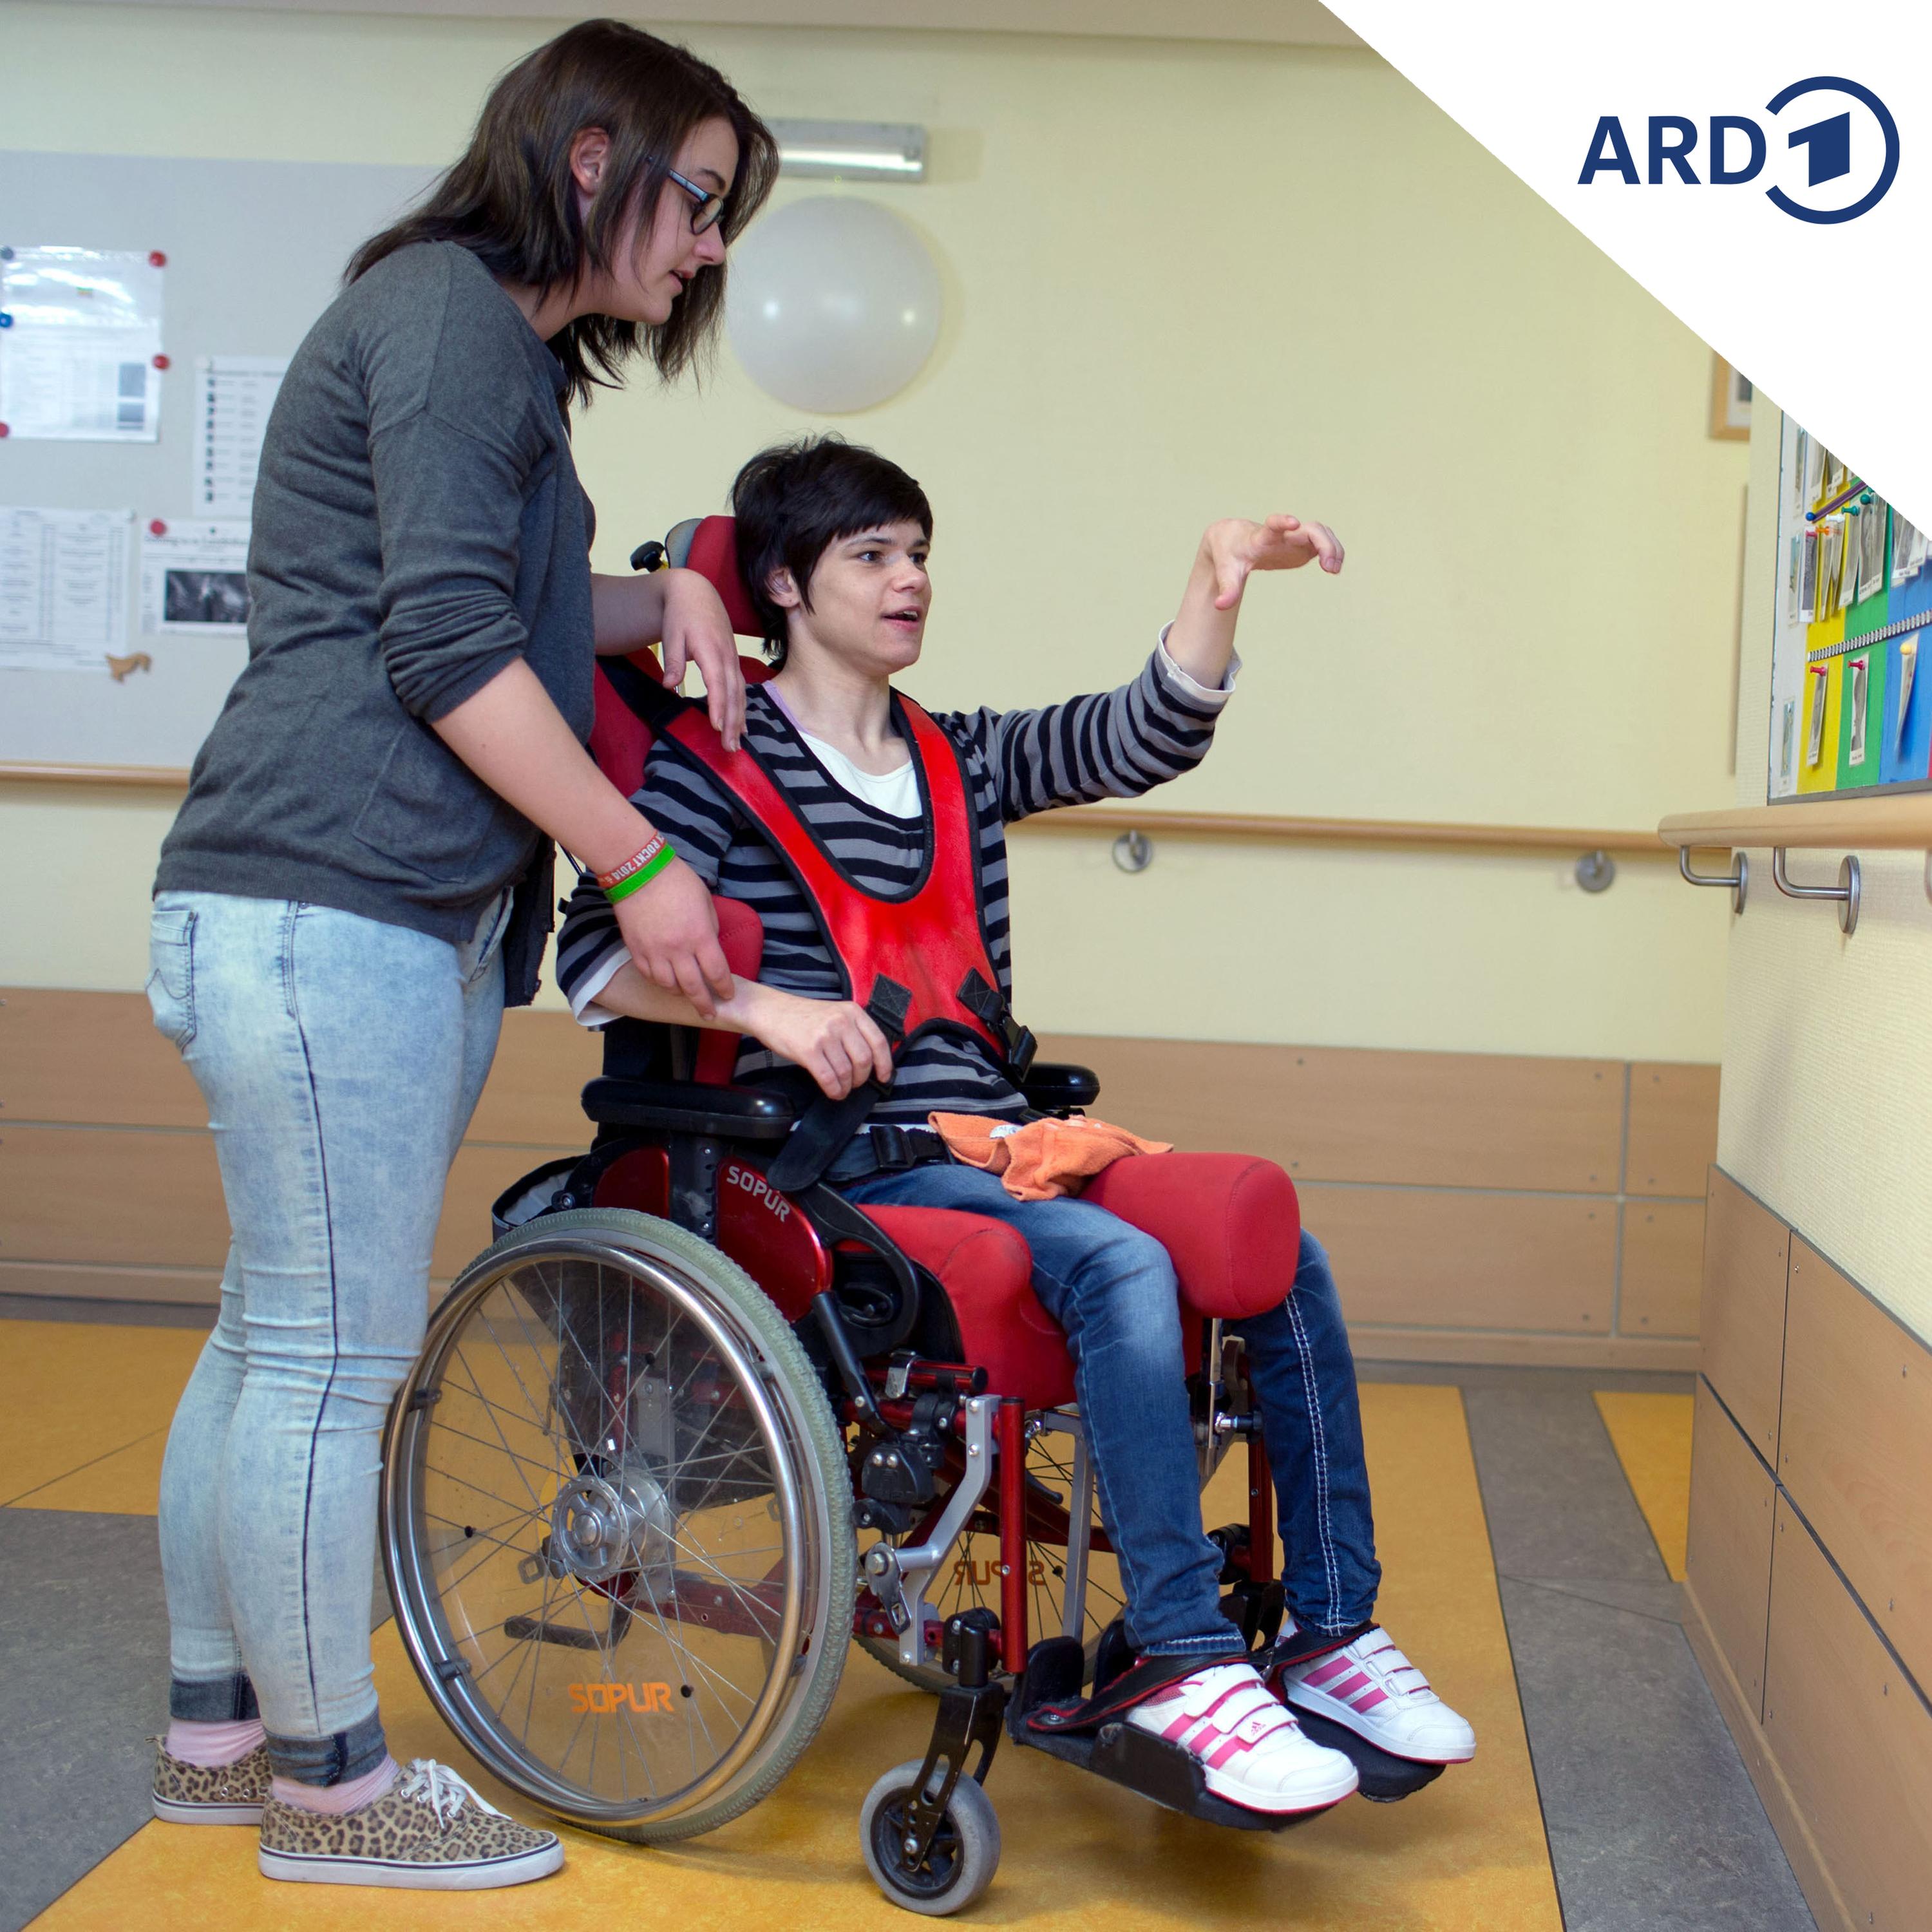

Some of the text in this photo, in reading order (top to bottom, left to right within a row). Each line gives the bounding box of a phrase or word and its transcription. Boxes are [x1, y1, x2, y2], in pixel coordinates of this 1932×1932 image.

[632, 838, 661, 867] ROCKT
[611, 861, 636, 880] 2014
[726, 1166, 790, 1222] SOPUR
[567, 1682, 675, 1713] SOPUR
